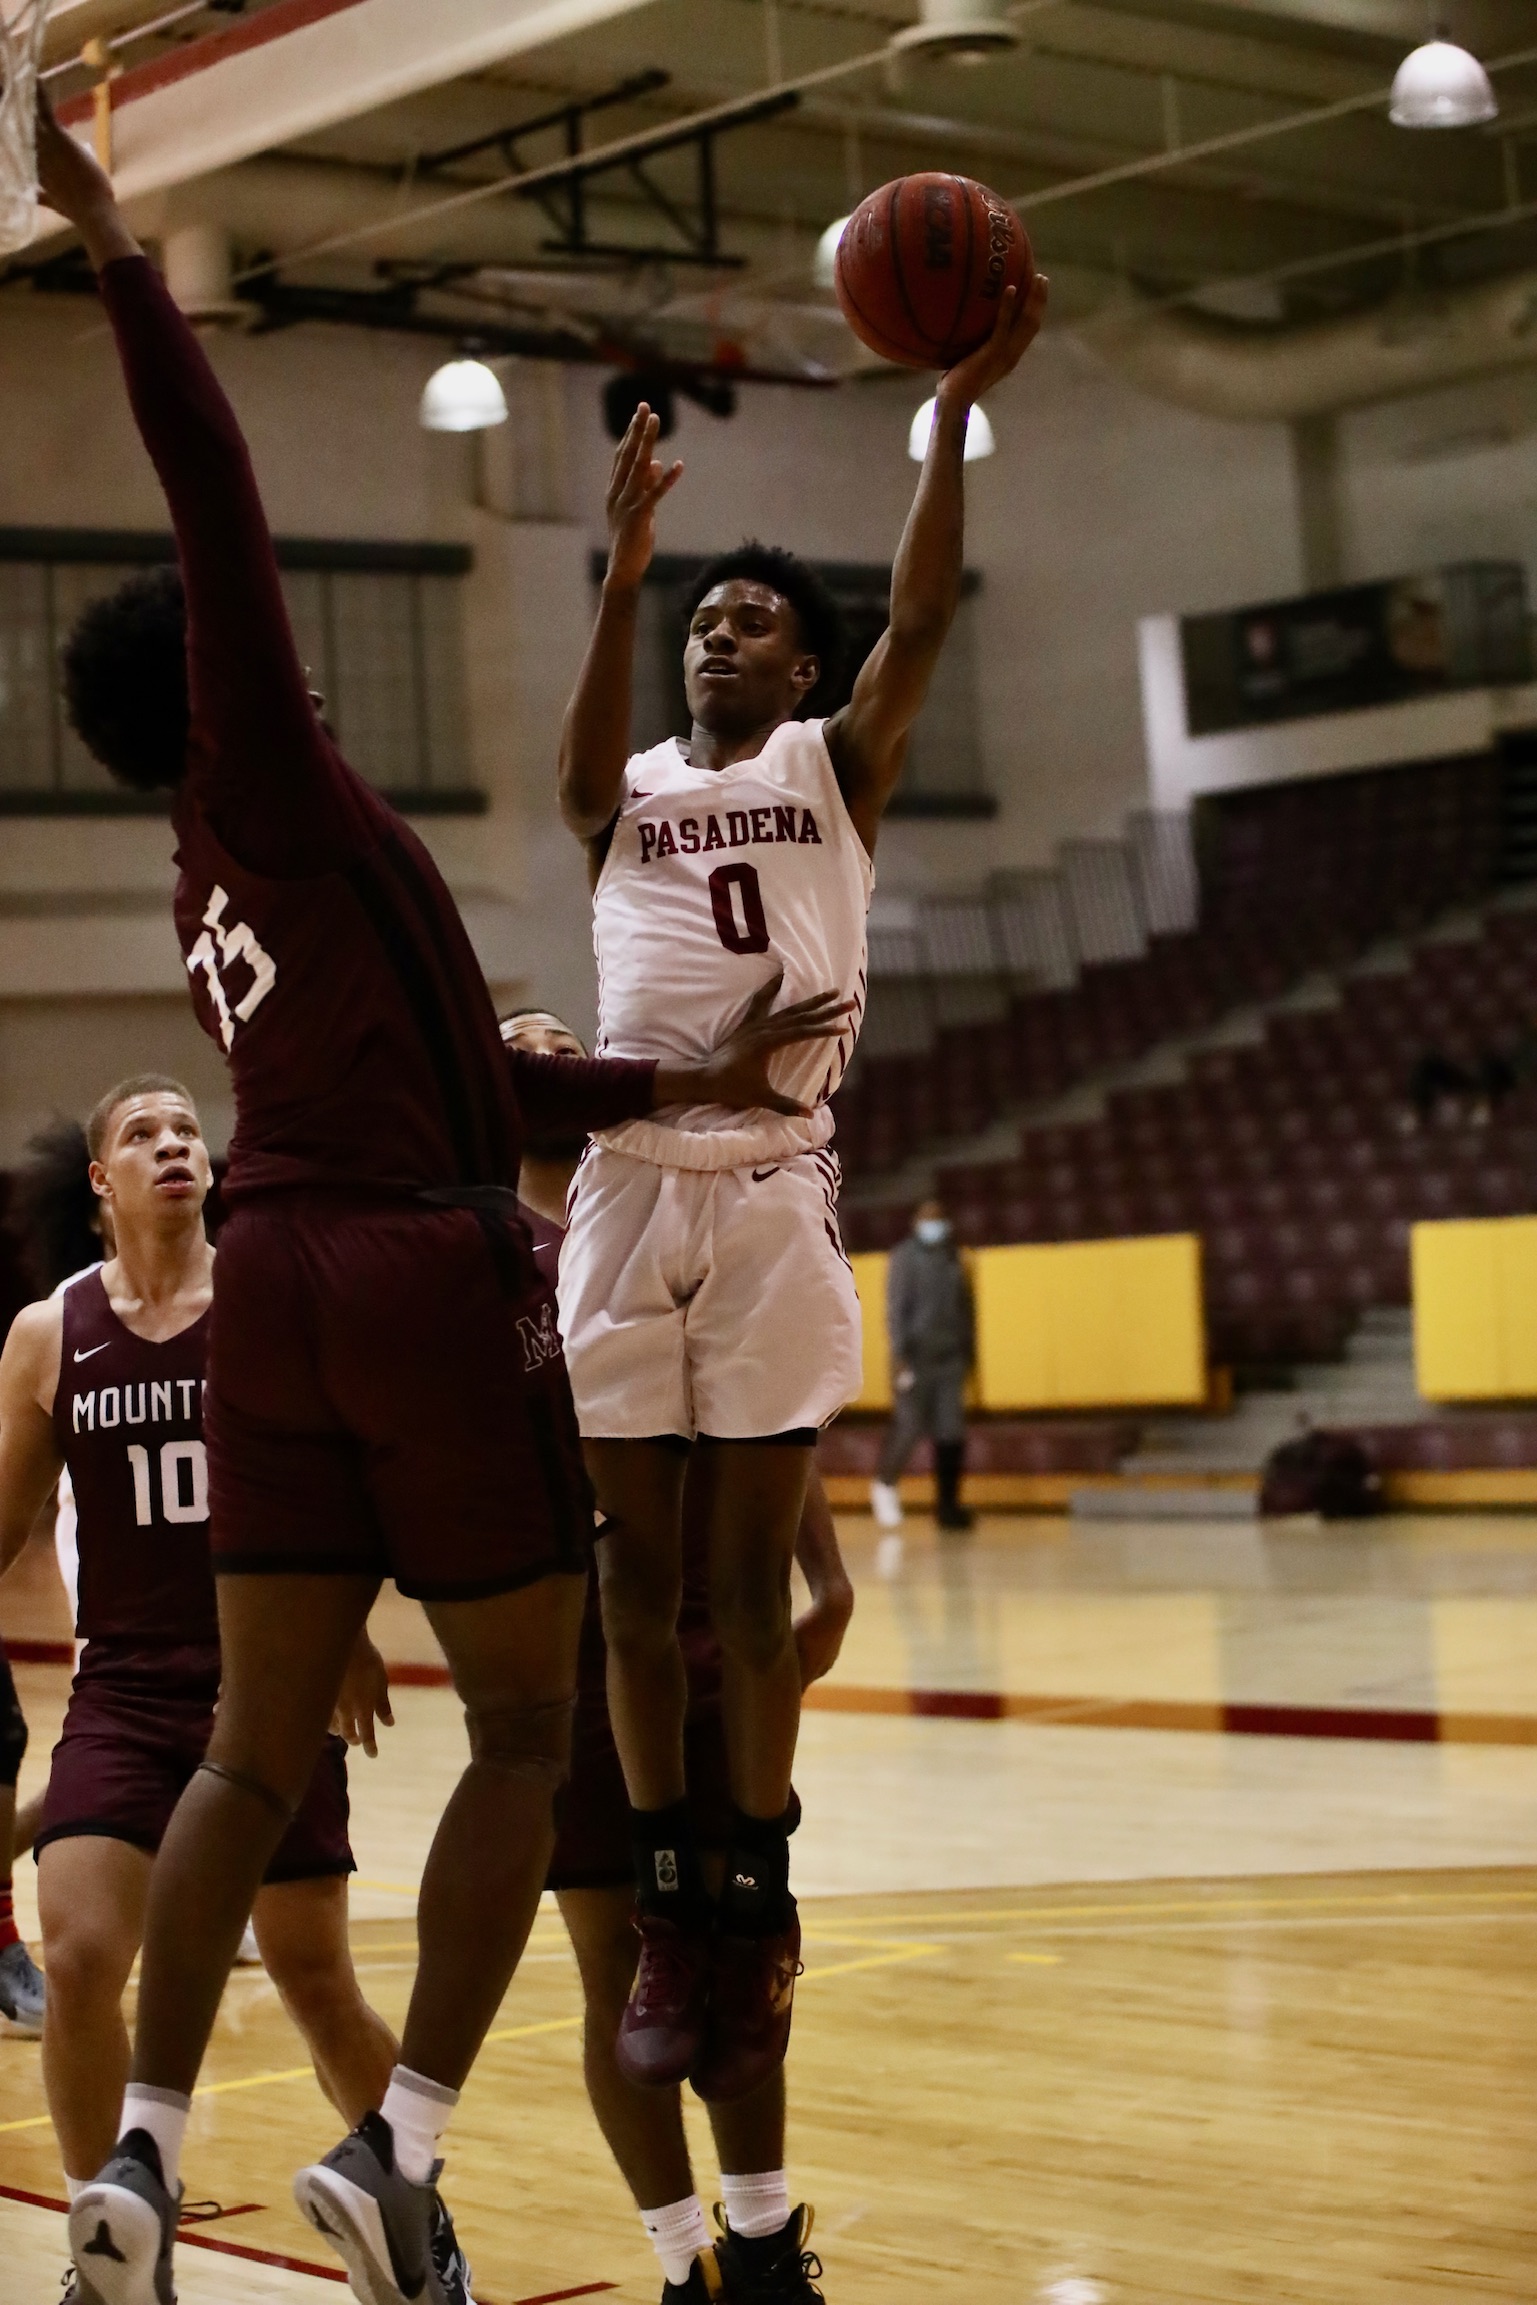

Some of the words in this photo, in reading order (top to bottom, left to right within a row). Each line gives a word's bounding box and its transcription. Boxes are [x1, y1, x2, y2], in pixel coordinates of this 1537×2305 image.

[637, 806, 822, 863] PASADENA
[708, 862, 770, 954] 0
[515, 1303, 560, 1372] M
[127, 1440, 210, 1525] 10
